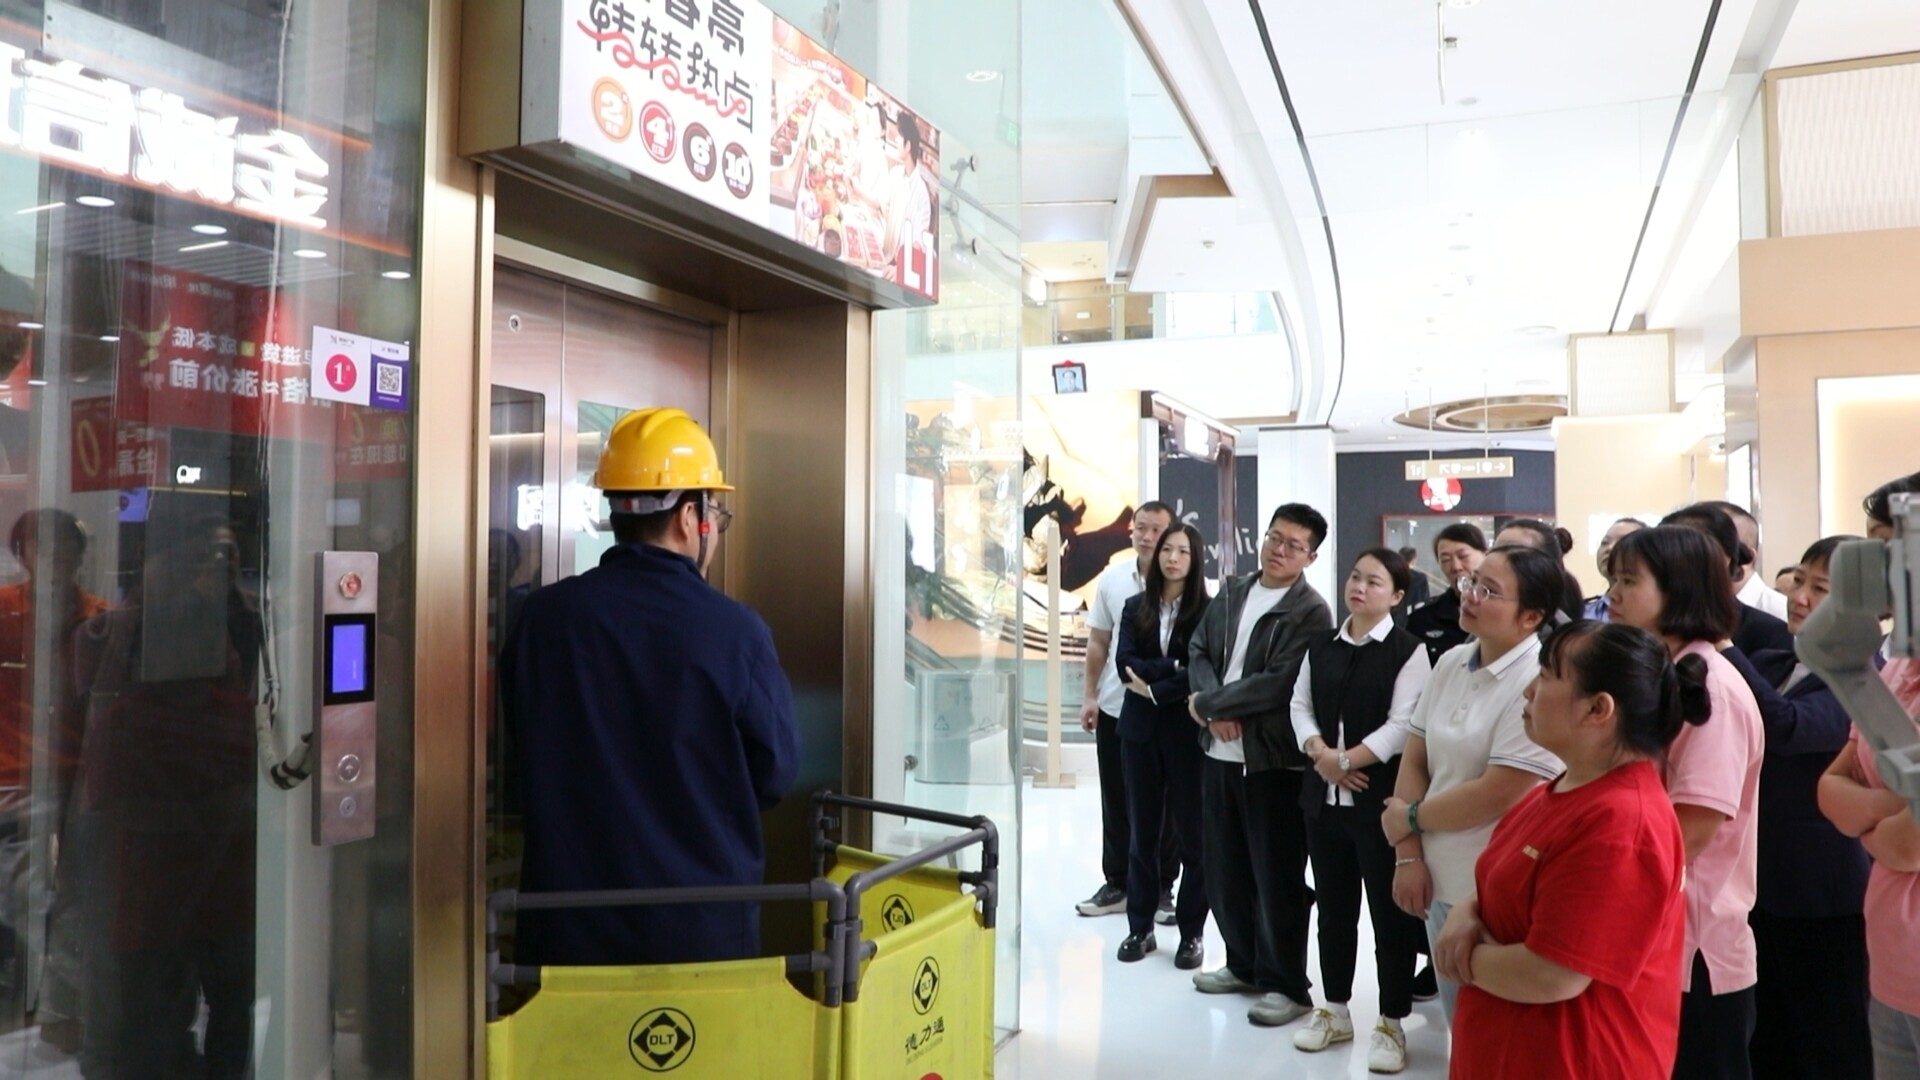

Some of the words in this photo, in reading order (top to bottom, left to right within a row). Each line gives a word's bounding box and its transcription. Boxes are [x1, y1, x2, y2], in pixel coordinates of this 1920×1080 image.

[904, 221, 934, 296] L1
[649, 1033, 675, 1046] DLT
[905, 1015, 945, 1055] 德力通
